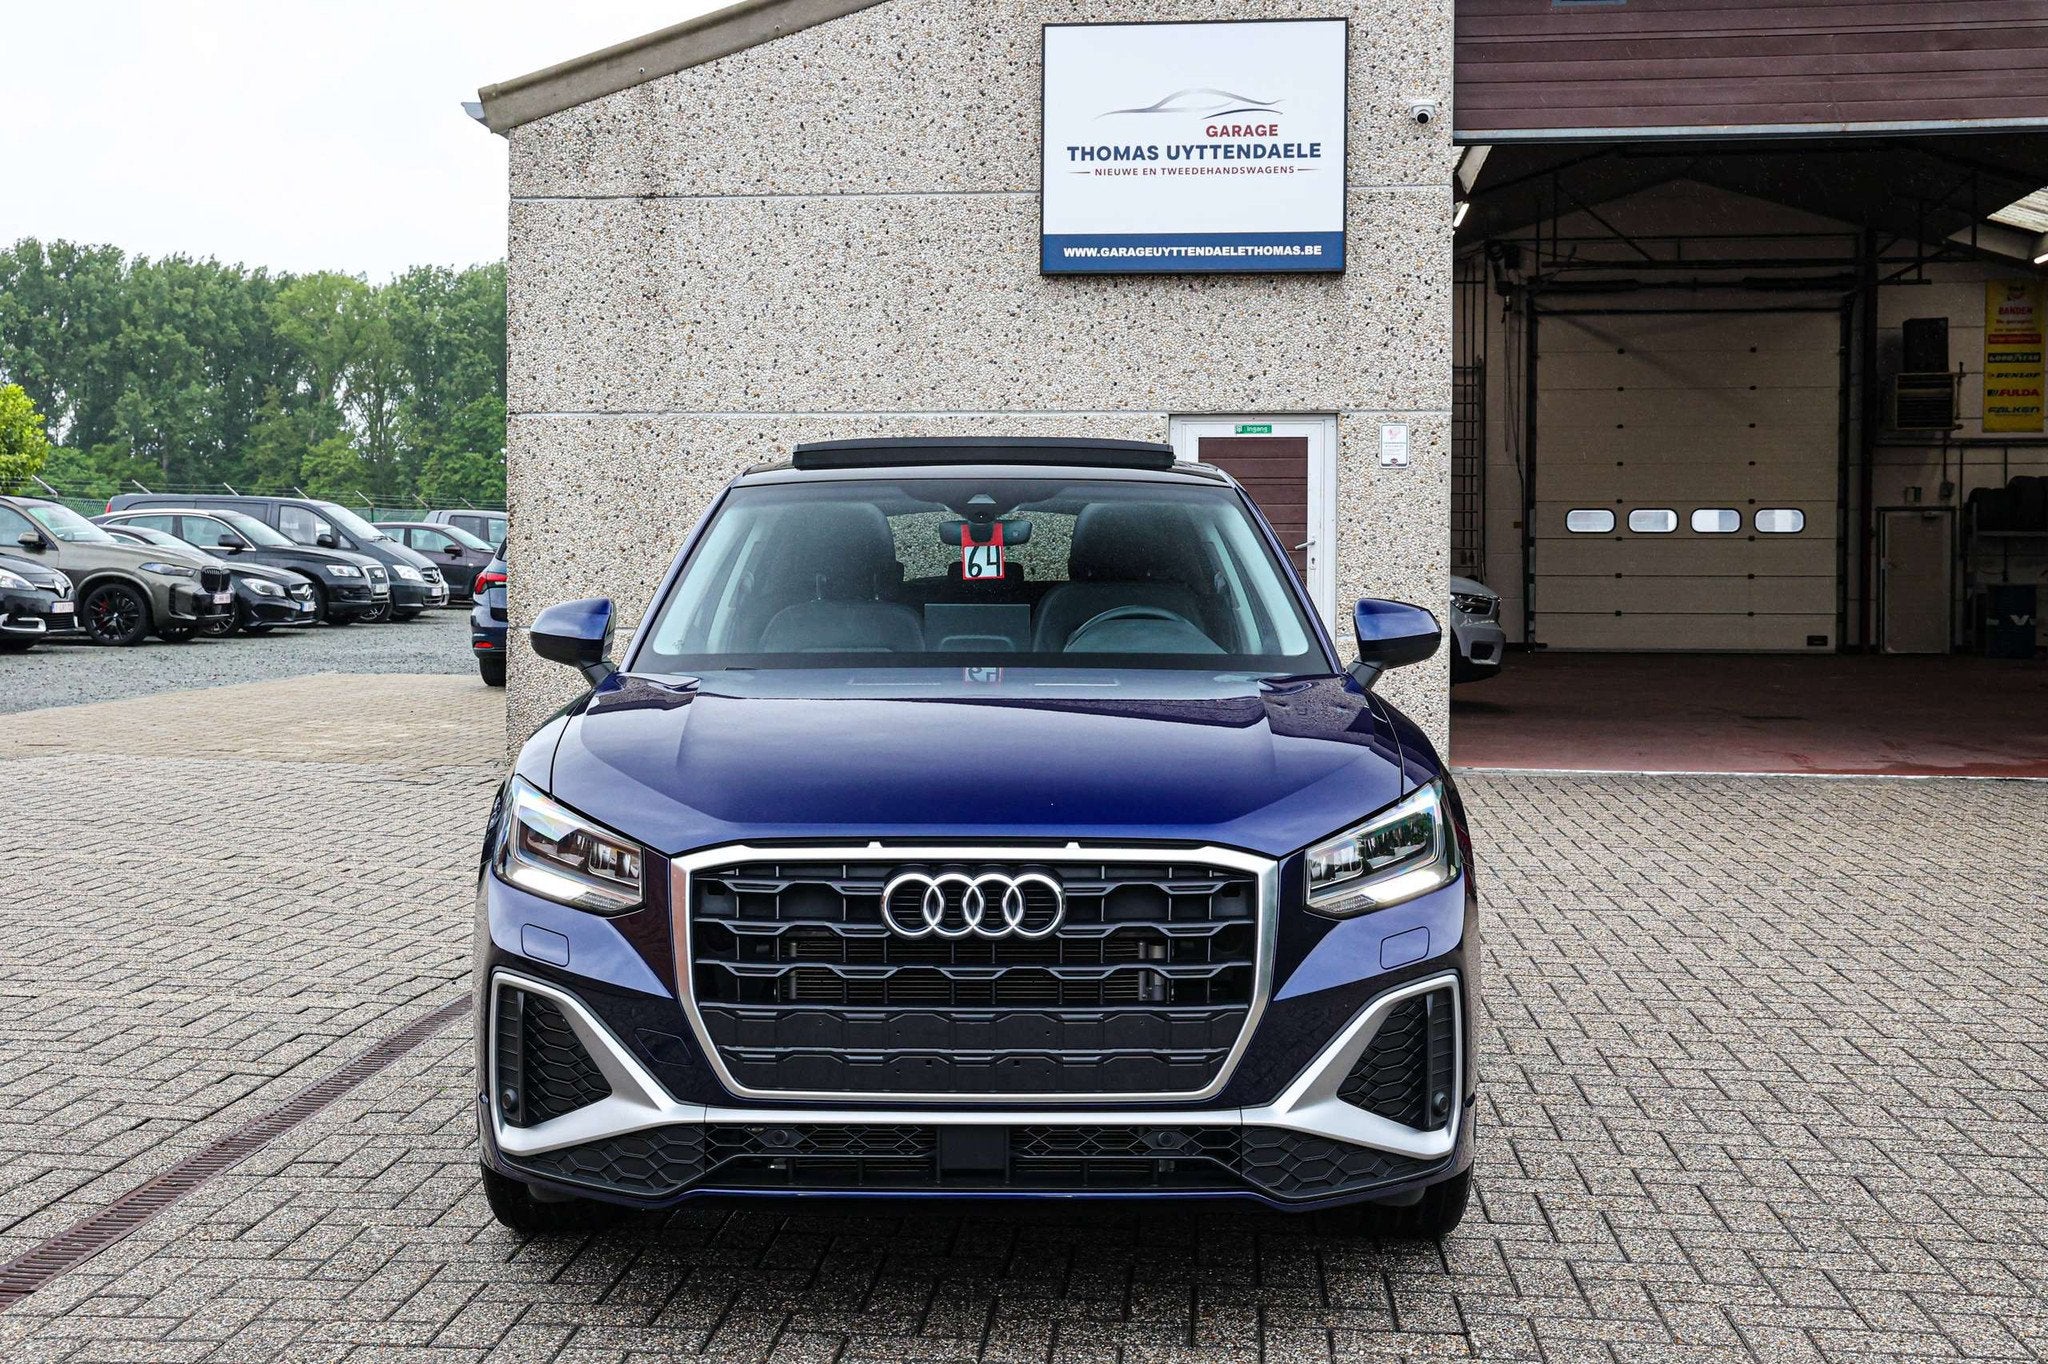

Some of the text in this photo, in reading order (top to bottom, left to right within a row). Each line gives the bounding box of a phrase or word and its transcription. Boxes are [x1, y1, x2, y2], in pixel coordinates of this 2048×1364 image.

[1205, 124, 1279, 138] GARAGE
[1067, 142, 1322, 161] THOMAS UYTTENDAELE
[1094, 165, 1295, 176] NIEUWE EN TWEEDEHANDSWAGENS
[1063, 245, 1322, 258] WWW.GARAGEUYTTENDAELETHOMAS.BE
[1999, 388, 2039, 397] FULDA
[1246, 425, 1268, 433] Ingang
[967, 546, 1000, 577] 64
